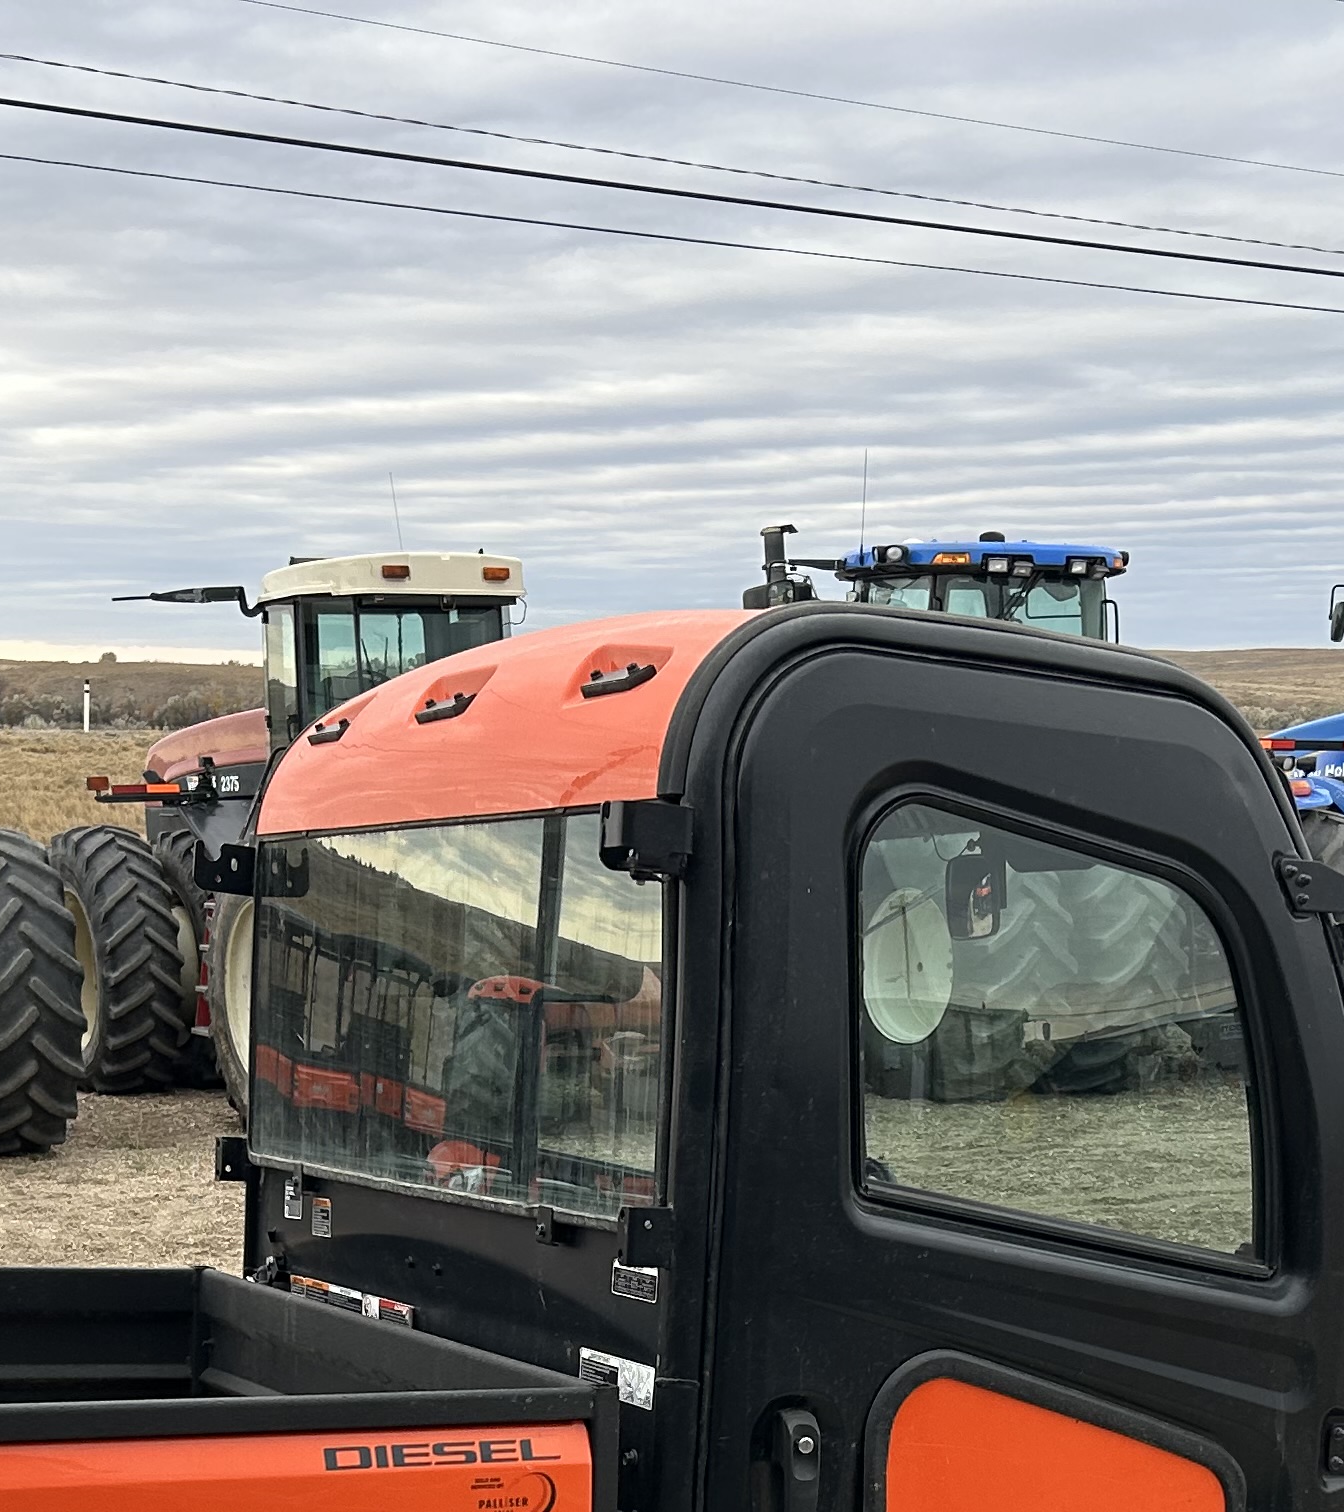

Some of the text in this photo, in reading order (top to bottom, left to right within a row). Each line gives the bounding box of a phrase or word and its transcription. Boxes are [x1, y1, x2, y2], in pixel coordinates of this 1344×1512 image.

[220, 775, 240, 792] 2375
[323, 1438, 561, 1471] DIESEL
[478, 1496, 529, 1510] PALLISER
